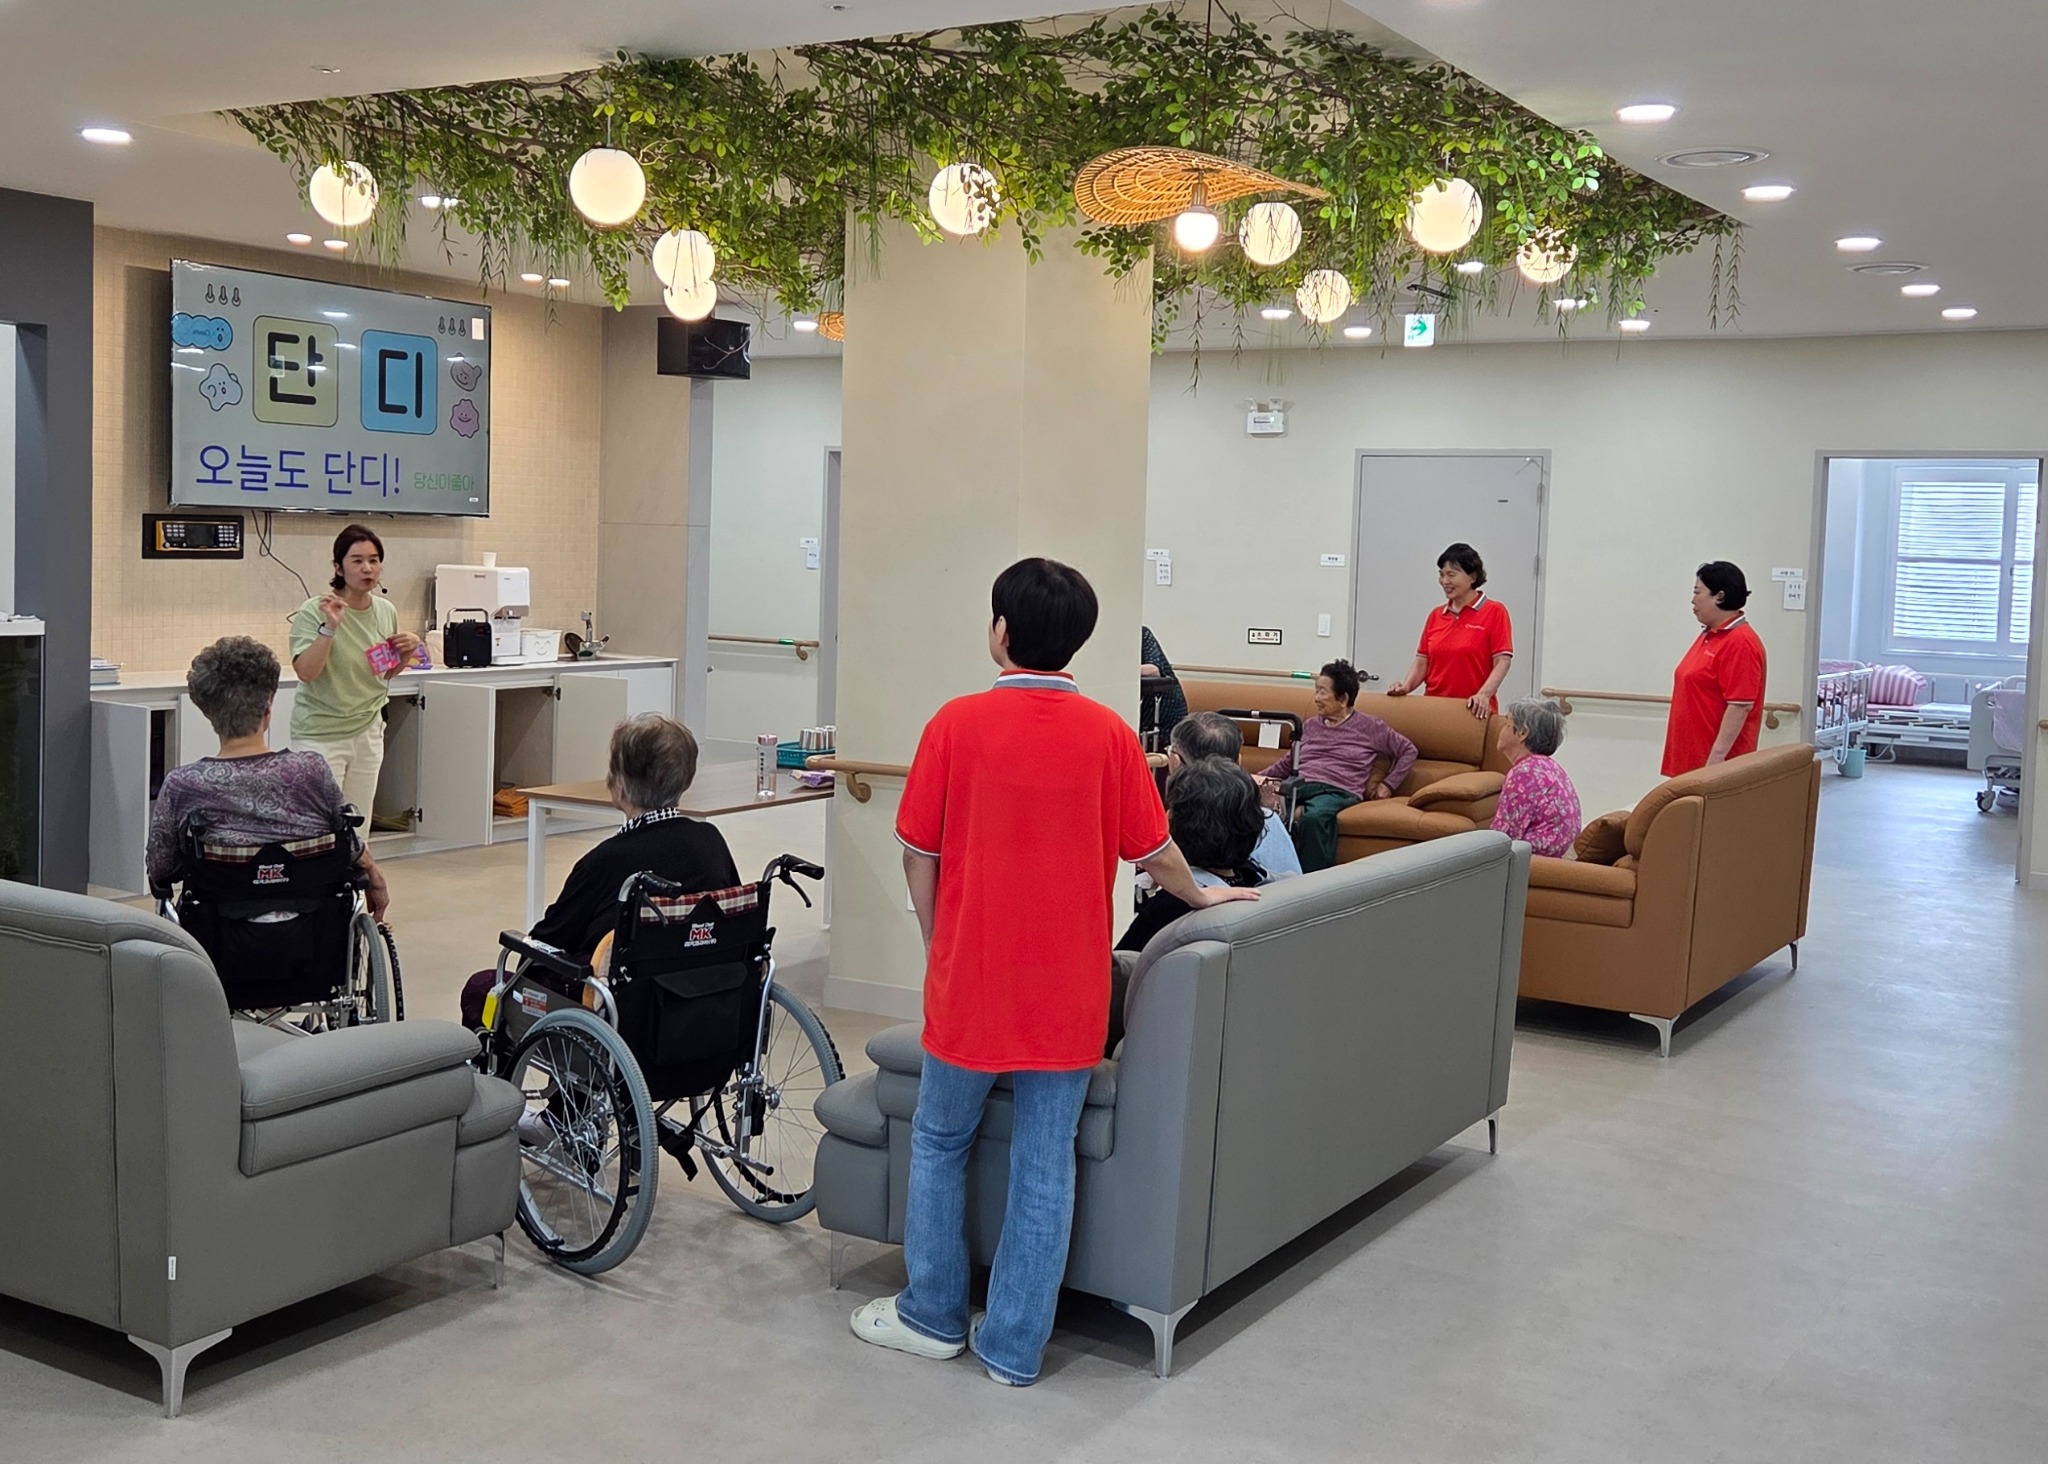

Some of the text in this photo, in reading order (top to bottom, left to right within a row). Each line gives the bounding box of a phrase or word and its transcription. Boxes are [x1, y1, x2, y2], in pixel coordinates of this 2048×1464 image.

[196, 445, 400, 497] 오늘도 단디!
[689, 926, 714, 941] MK
